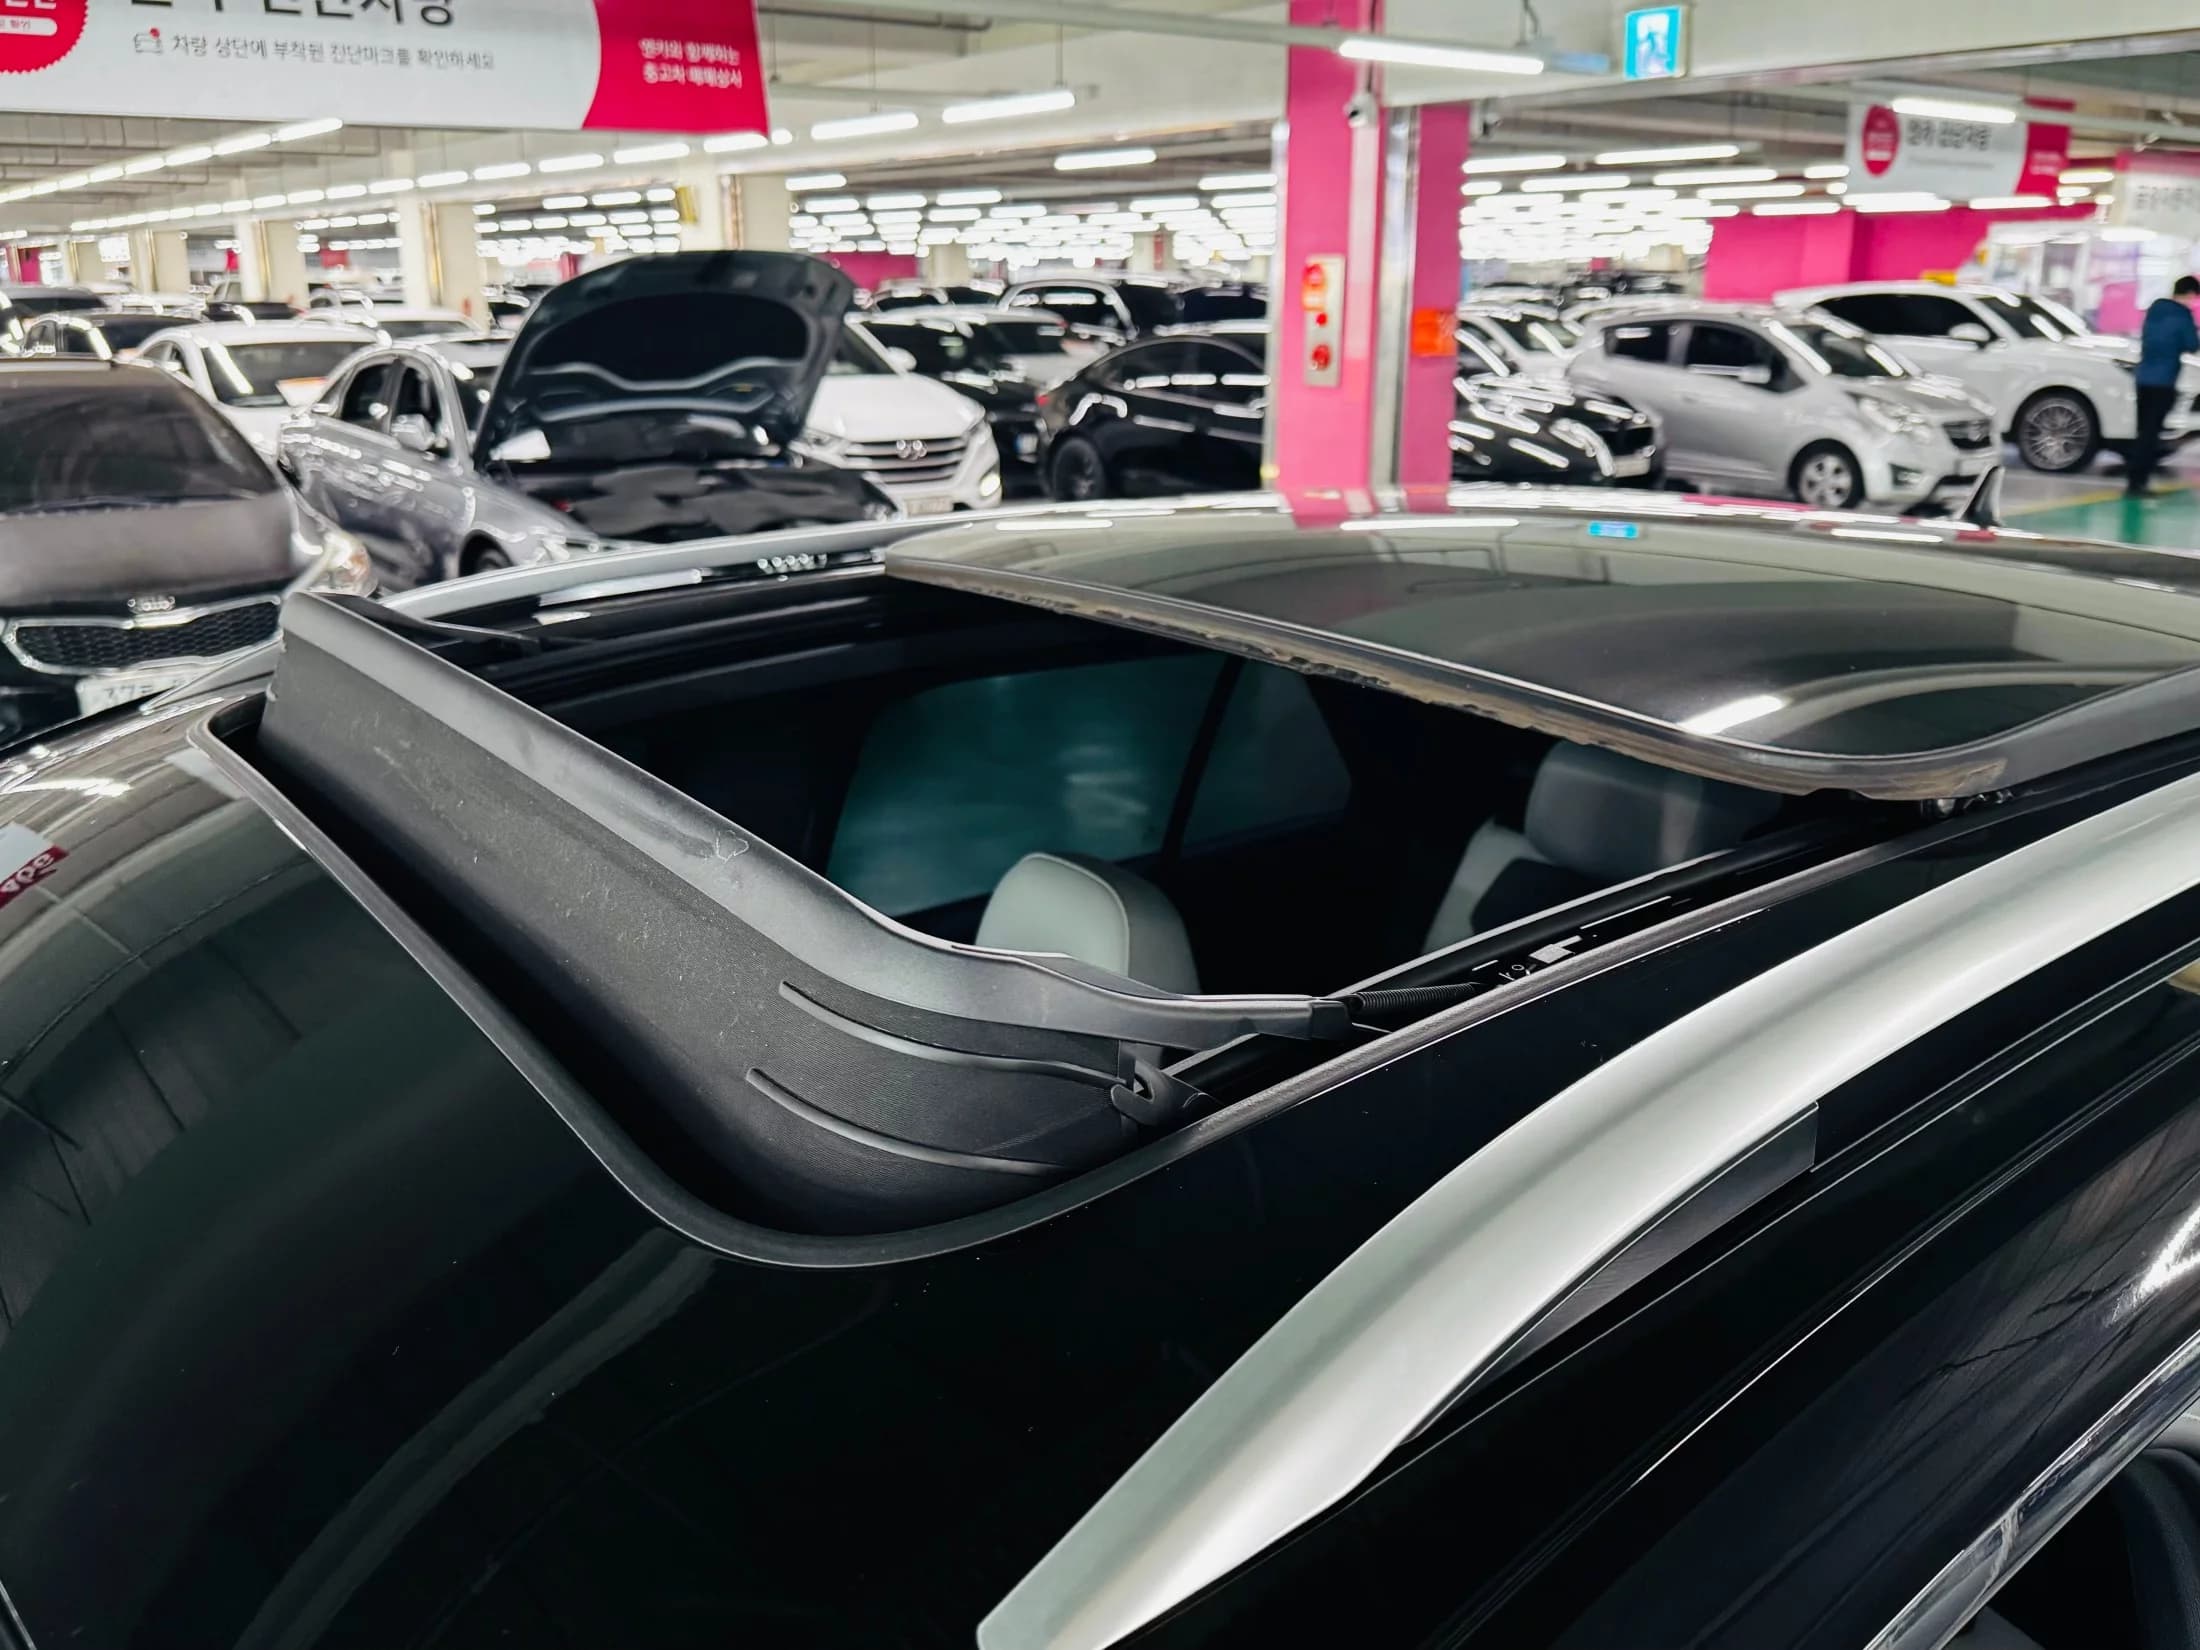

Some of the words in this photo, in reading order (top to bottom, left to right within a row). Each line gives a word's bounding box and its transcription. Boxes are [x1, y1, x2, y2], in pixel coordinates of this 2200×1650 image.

[172, 34, 207, 57] 차량
[214, 36, 267, 59] 상단에
[272, 40, 325, 63] 부착된
[330, 43, 410, 66] 진단마크를
[417, 48, 494, 70] 확인하세요
[643, 61, 686, 85] 중고차
